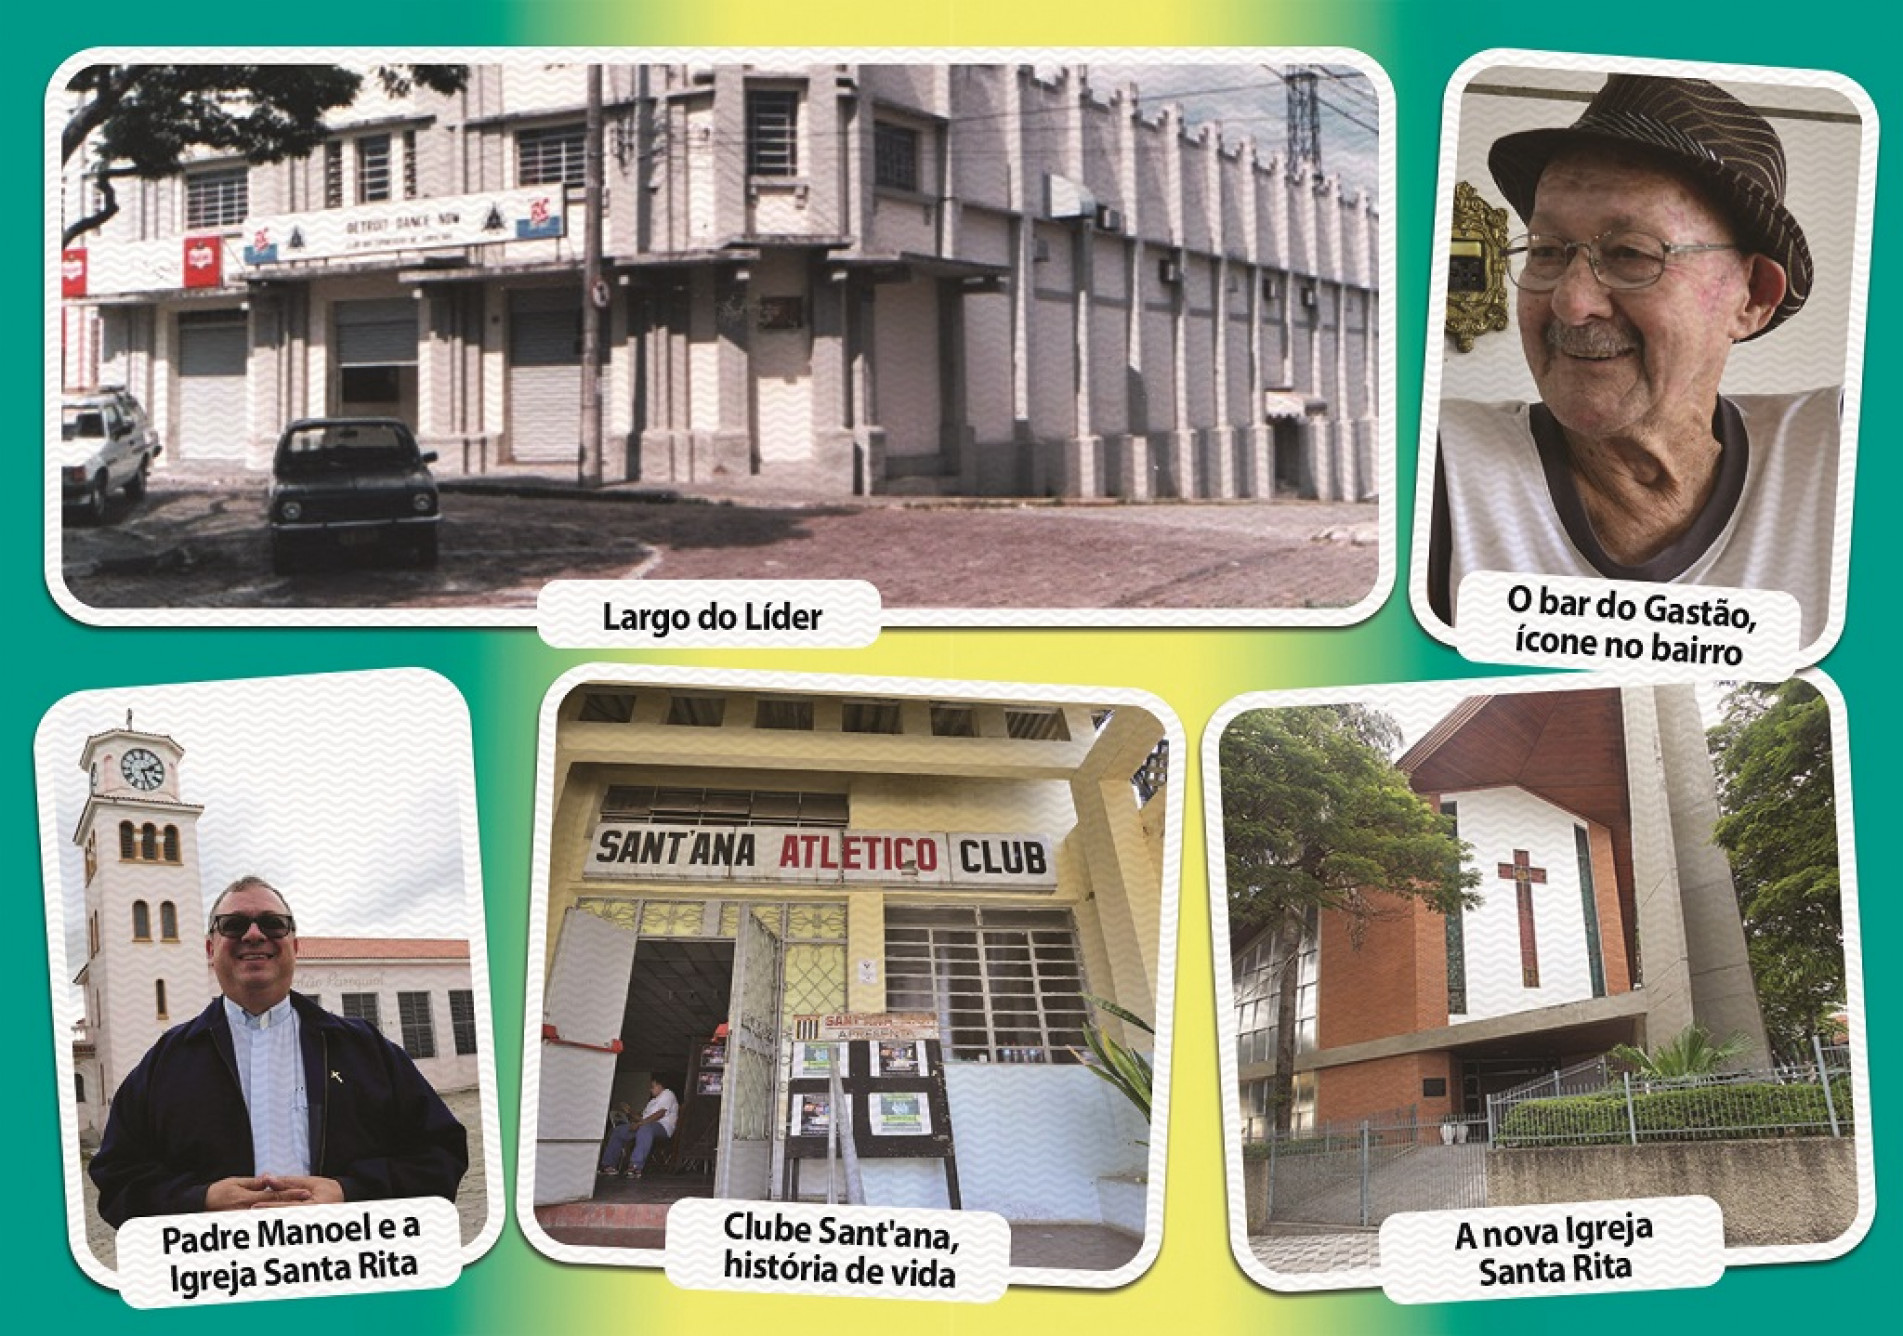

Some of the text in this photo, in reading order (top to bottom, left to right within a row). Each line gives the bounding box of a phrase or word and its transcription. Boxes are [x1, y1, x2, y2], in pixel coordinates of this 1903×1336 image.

[596, 829, 1047, 874] SANT'ANA ATLETICO CLUB
